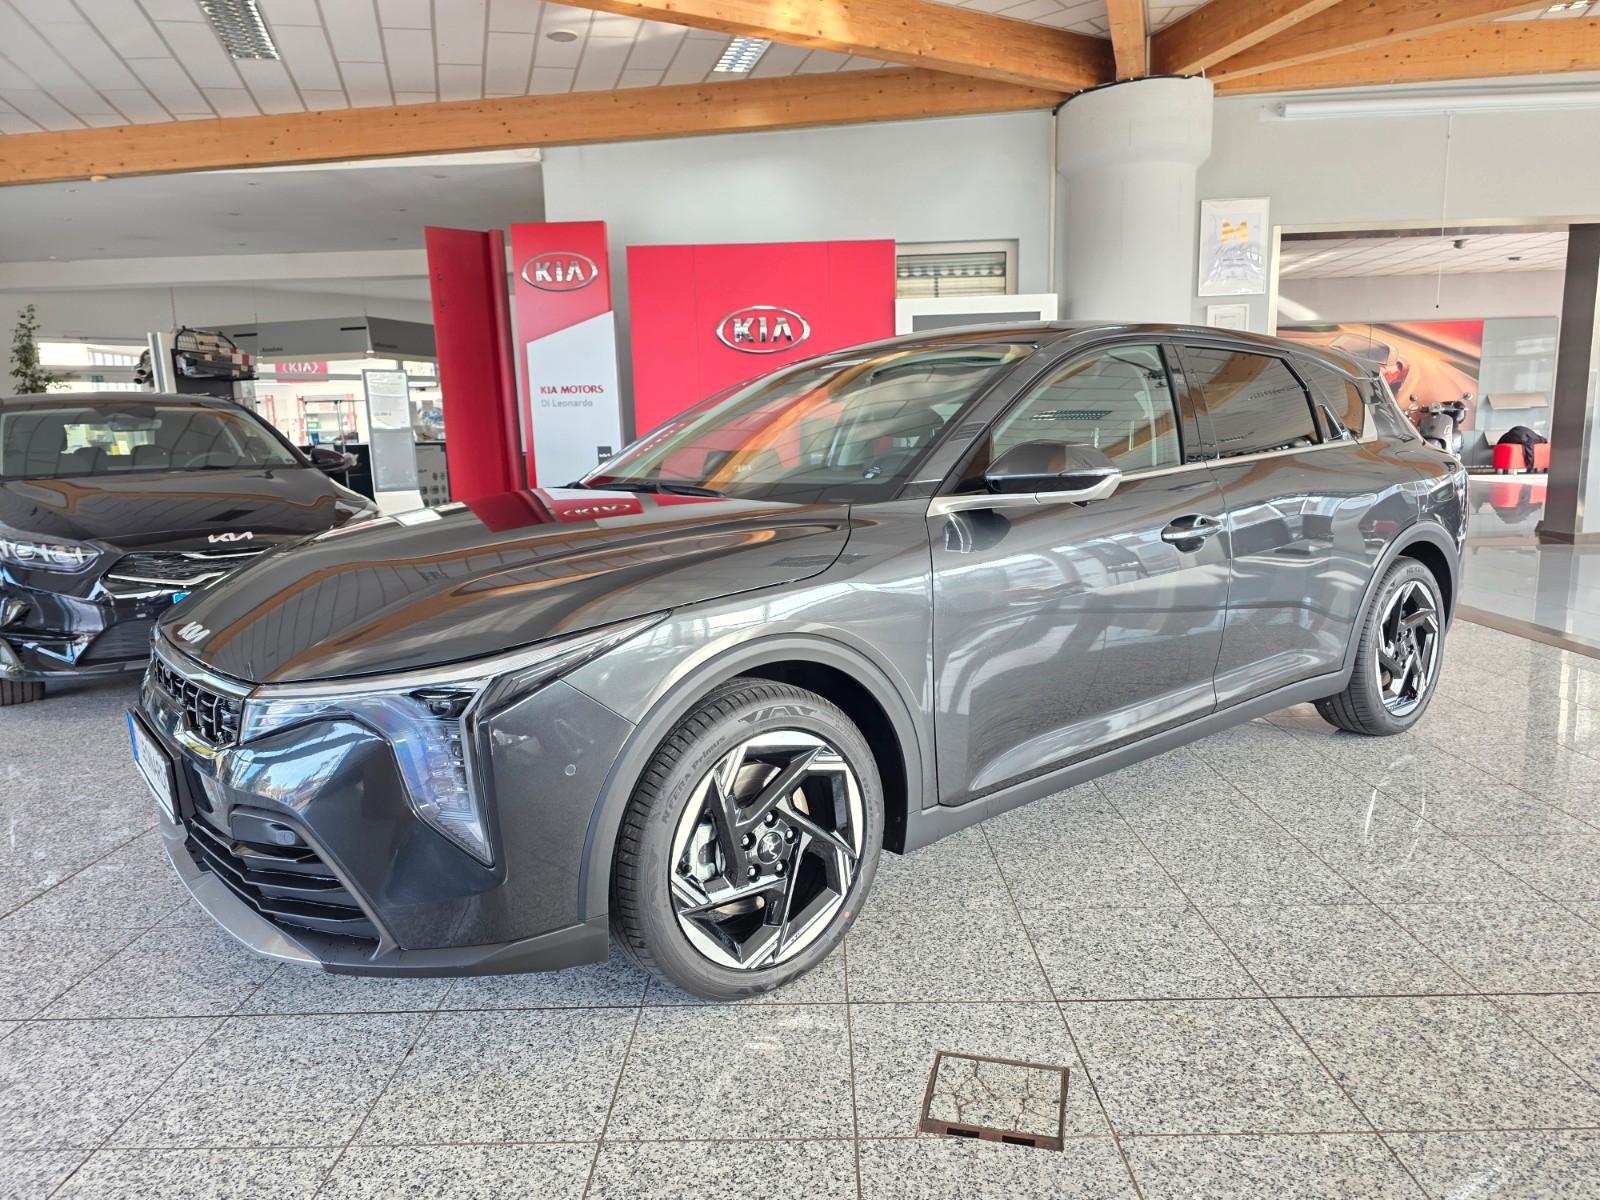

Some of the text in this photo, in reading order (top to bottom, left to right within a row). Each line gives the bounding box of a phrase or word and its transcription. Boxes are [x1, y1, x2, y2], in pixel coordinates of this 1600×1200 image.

[535, 261, 585, 282] KIA
[733, 317, 794, 343] KIA
[540, 385, 604, 394] KIA MOTORS
